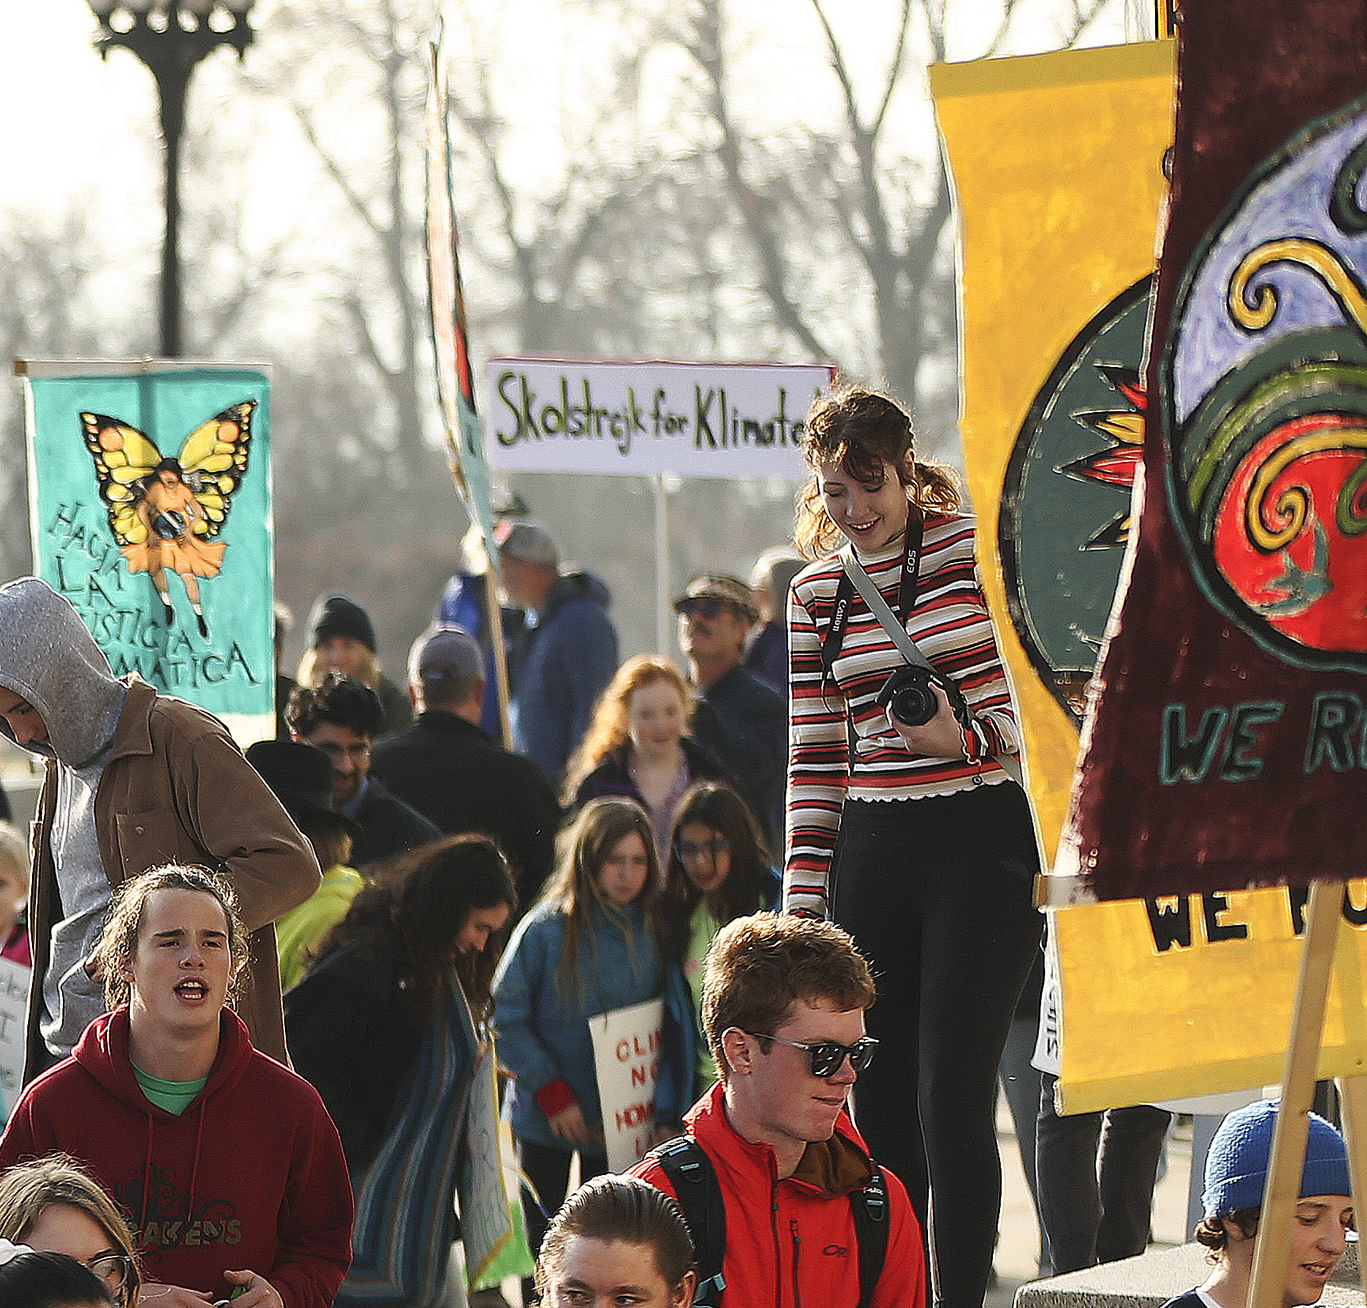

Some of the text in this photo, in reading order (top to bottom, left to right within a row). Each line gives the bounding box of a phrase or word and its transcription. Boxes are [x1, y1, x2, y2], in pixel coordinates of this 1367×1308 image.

[47, 501, 128, 592] HACIA
[906, 548, 918, 575] EOS
[55, 555, 116, 609] LA
[830, 597, 850, 633] Canon
[1159, 700, 1285, 787] WE
[130, 1219, 243, 1246] AKENS
